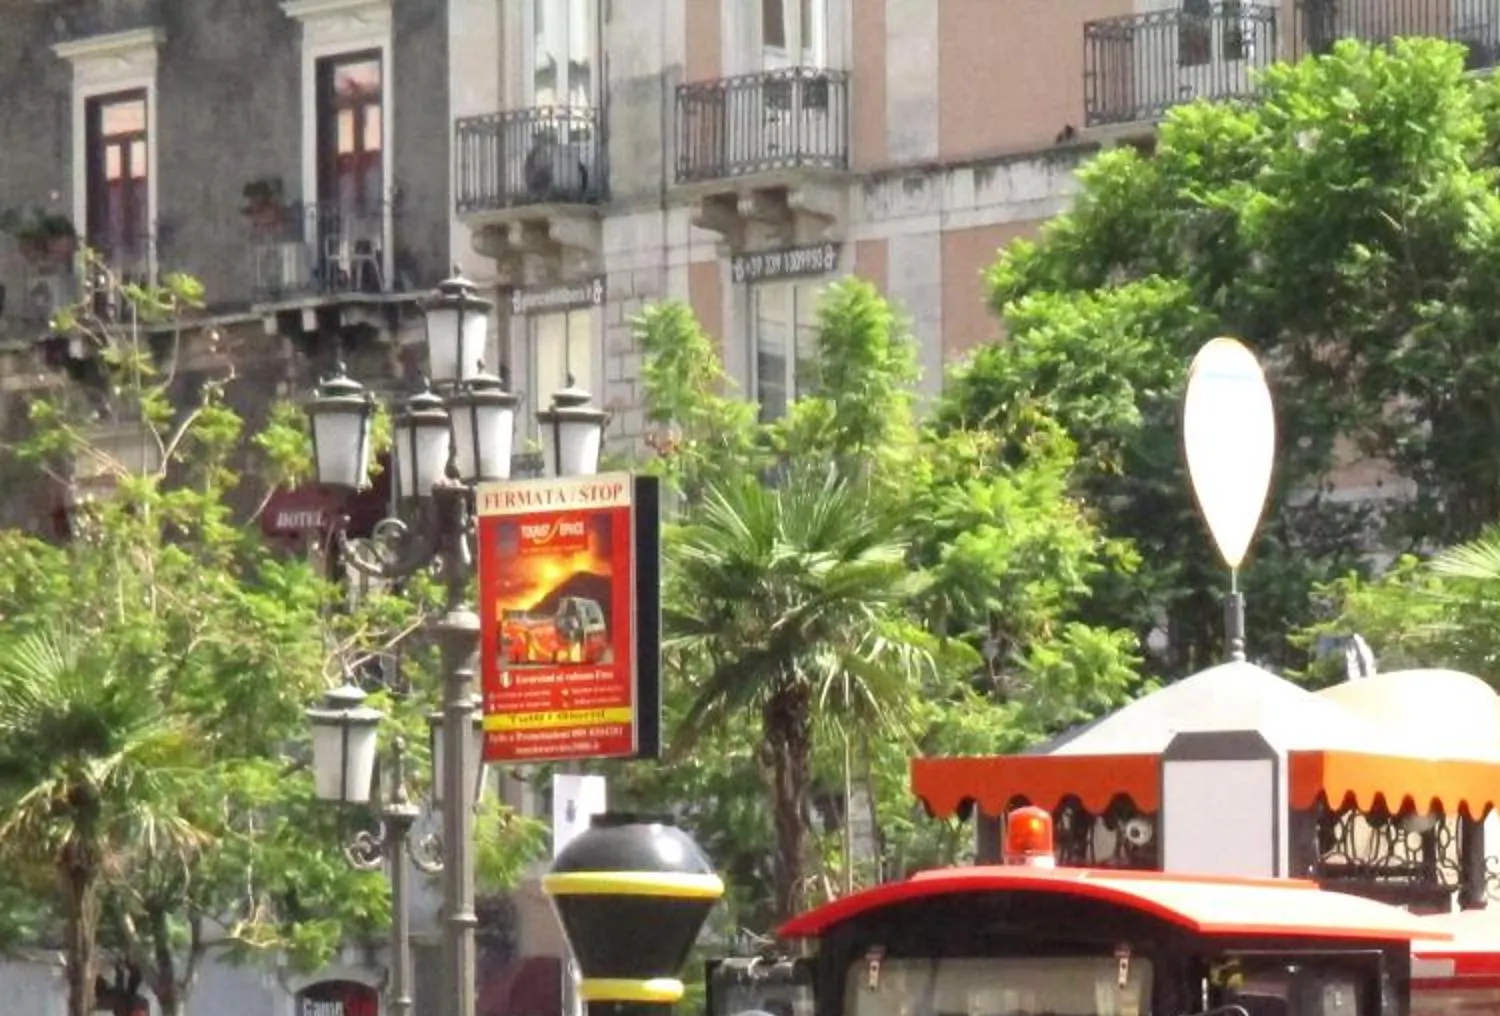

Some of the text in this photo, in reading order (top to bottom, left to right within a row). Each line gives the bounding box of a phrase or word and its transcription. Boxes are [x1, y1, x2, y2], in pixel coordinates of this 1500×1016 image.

[485, 489, 566, 510] FERMATA
[579, 483, 622, 502] STOP
[277, 511, 325, 528] HOTEL
